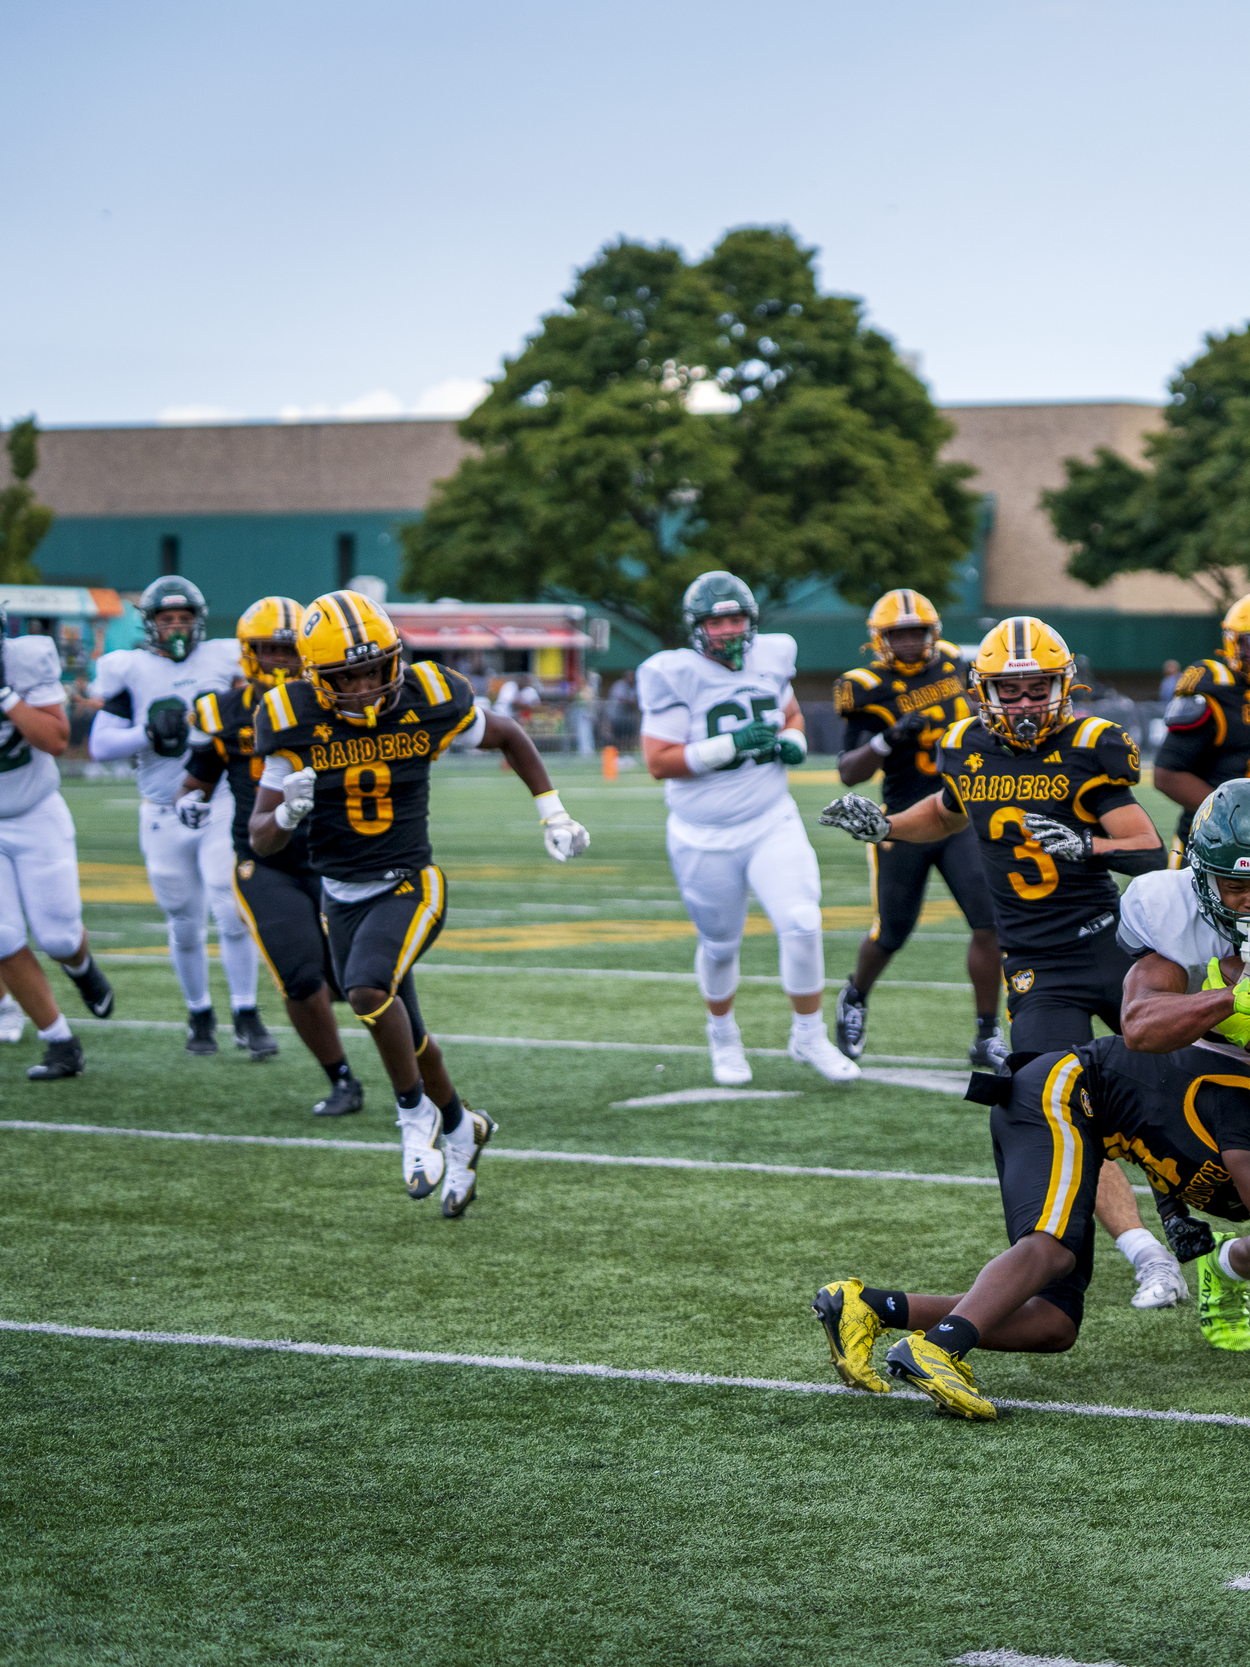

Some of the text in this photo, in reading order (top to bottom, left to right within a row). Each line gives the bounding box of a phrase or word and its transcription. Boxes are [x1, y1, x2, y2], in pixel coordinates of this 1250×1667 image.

[303, 609, 322, 638] 8
[310, 729, 431, 771] RAIDERS
[344, 760, 394, 836] 8
[958, 774, 1070, 801] RAIDERS
[988, 806, 1059, 900] 3
